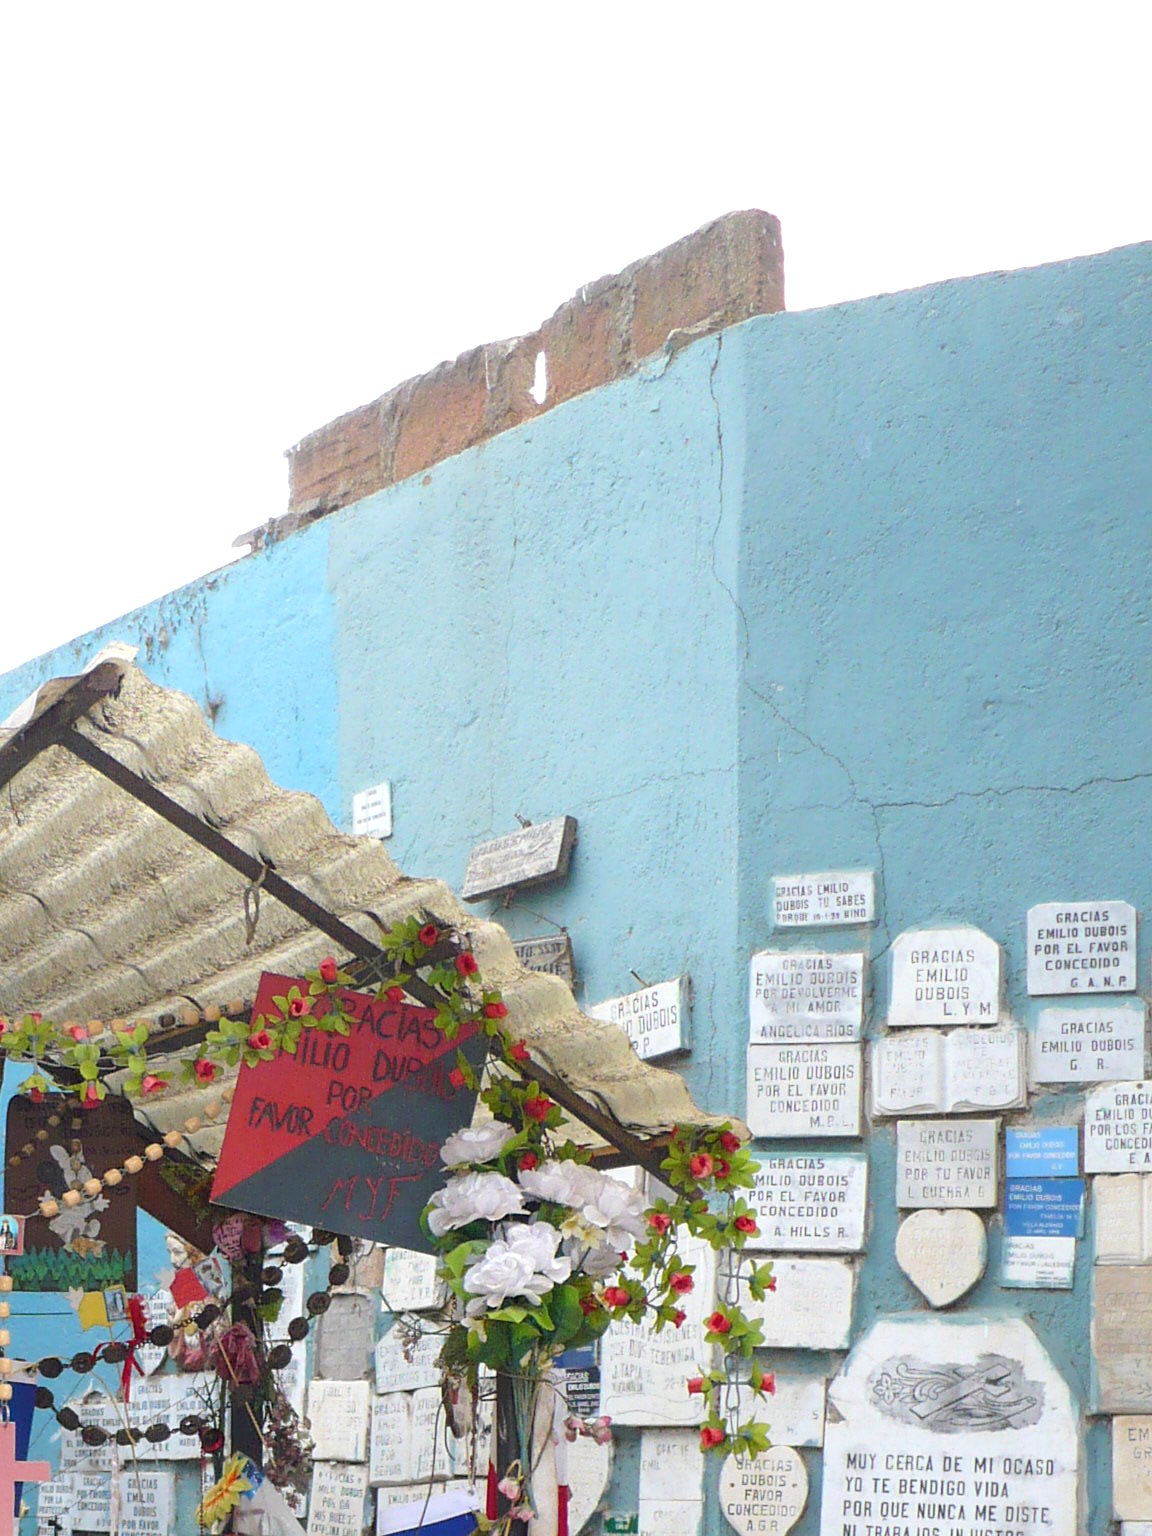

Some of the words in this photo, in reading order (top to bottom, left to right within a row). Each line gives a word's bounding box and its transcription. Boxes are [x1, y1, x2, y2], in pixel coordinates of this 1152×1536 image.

[776, 886, 812, 898] GRACIAS
[817, 883, 848, 895] EMILIO
[777, 900, 809, 912] DUBOIS
[818, 898, 829, 908] TU
[836, 894, 866, 906] SABES
[1056, 910, 1109, 924] GRACIAS
[1038, 927, 1078, 939] EMILIO
[1084, 925, 1127, 938] DUBOIS
[1035, 944, 1059, 956] POR
[1067, 943, 1082, 954] EL
[1089, 941, 1128, 953] FAVOR
[911, 949, 976, 964] GRACIAS
[782, 960, 832, 970] GRACIAS
[1045, 957, 1120, 971] CONCEDIDO
[756, 972, 802, 986] EMILIO
[810, 972, 857, 985] DUBOIS
[916, 967, 968, 983] EMILIO
[755, 989, 776, 1000] POR
[782, 988, 857, 1000] DEVOLVERME
[915, 986, 969, 1001] DUBOIS
[808, 1001, 841, 1013] AMOR
[639, 1005, 678, 1033] DUBOIS
[760, 1025, 820, 1038] ANGELICA
[826, 1024, 855, 1037] RIOS
[1061, 1021, 1113, 1035] GRACIAS
[1041, 1040, 1081, 1053] EMILIO
[1091, 1038, 1134, 1051] DUBOIS
[779, 1050, 827, 1064] GRACIAS
[755, 1066, 800, 1082] EMILIO
[806, 1065, 855, 1080] DUBOIS
[326, 1081, 372, 1112] POR
[757, 1085, 780, 1098] POR
[788, 1084, 803, 1097] EL
[810, 1083, 846, 1096] FAVOR
[770, 1100, 839, 1113] CONCEDIDO
[248, 1097, 314, 1134] FAVOR
[1096, 1109, 1134, 1121] EMILIO
[920, 1129, 973, 1143] GRACIAS
[1090, 1123, 1110, 1136] POR
[1116, 1123, 1136, 1136] LOS
[904, 1150, 944, 1162] EMILIO
[951, 1150, 990, 1161] DUBOIS
[770, 1158, 825, 1170] GRACIAS
[799, 1175, 848, 1186] DUBOIS
[906, 1168, 928, 1180] POR
[936, 1167, 951, 1180] TU
[957, 1167, 990, 1180] FAVOR
[749, 1191, 773, 1202] POR
[780, 1191, 795, 1202] EL
[804, 1191, 846, 1203] FAVOR
[760, 1206, 838, 1217] CONCEDIDO
[790, 1226, 830, 1237] HILLS
[736, 1459, 793, 1473] GRACIAS
[846, 1453, 877, 1470] MUY
[885, 1454, 934, 1473] CERCA
[943, 1456, 963, 1473] DE
[974, 1457, 993, 1474] MI
[1003, 1458, 1054, 1477] OCASO
[741, 1474, 786, 1487] DUBOIS
[845, 1476, 862, 1493] YO
[872, 1477, 891, 1494] TE
[899, 1479, 966, 1497] BENDIGO
[974, 1481, 1009, 1499] VIDA
[745, 1489, 783, 1502] FAVOR
[727, 1503, 797, 1517] CONCEDIDO
[843, 1500, 872, 1518] POR
[880, 1501, 909, 1520] QUE
[917, 1502, 966, 1521] NUNCA
[975, 1504, 997, 1522] ME
